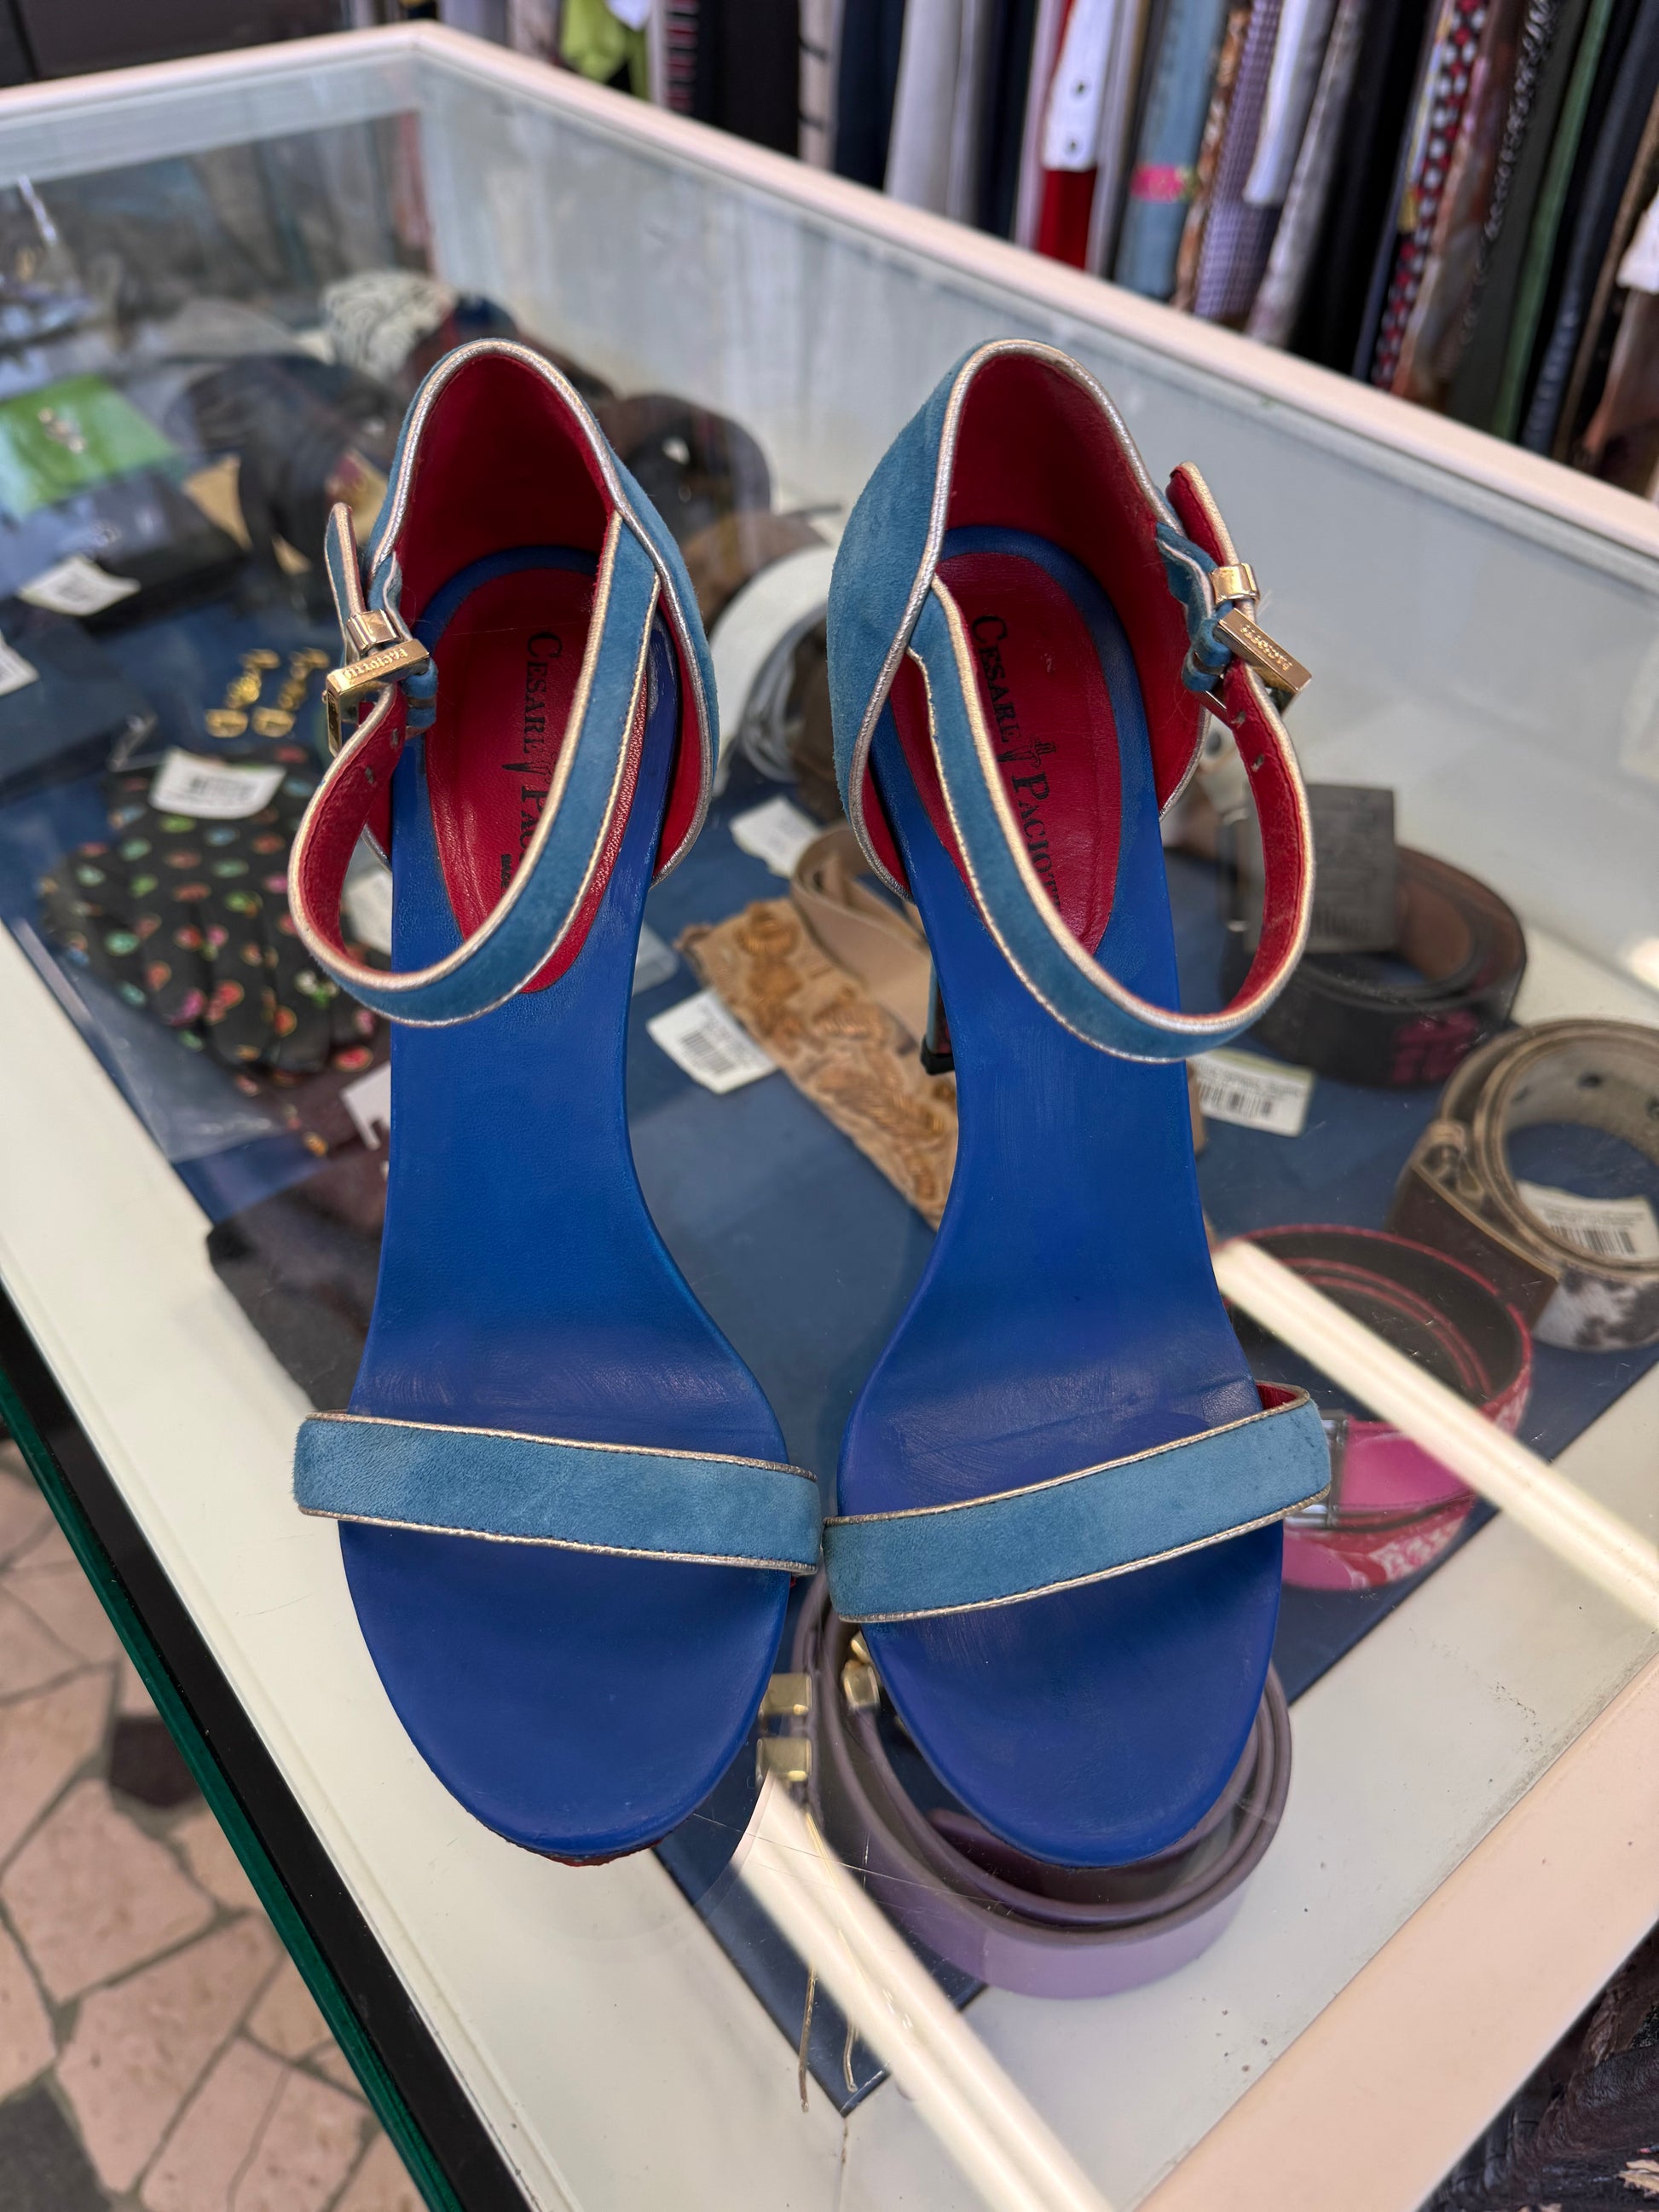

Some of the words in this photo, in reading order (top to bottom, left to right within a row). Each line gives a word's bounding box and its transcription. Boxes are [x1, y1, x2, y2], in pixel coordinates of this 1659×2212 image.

[523, 631, 563, 754] CESARE
[972, 614, 1021, 744] CESARE
[1009, 770, 1061, 910] PACIOT
[518, 785, 550, 863] PAC
